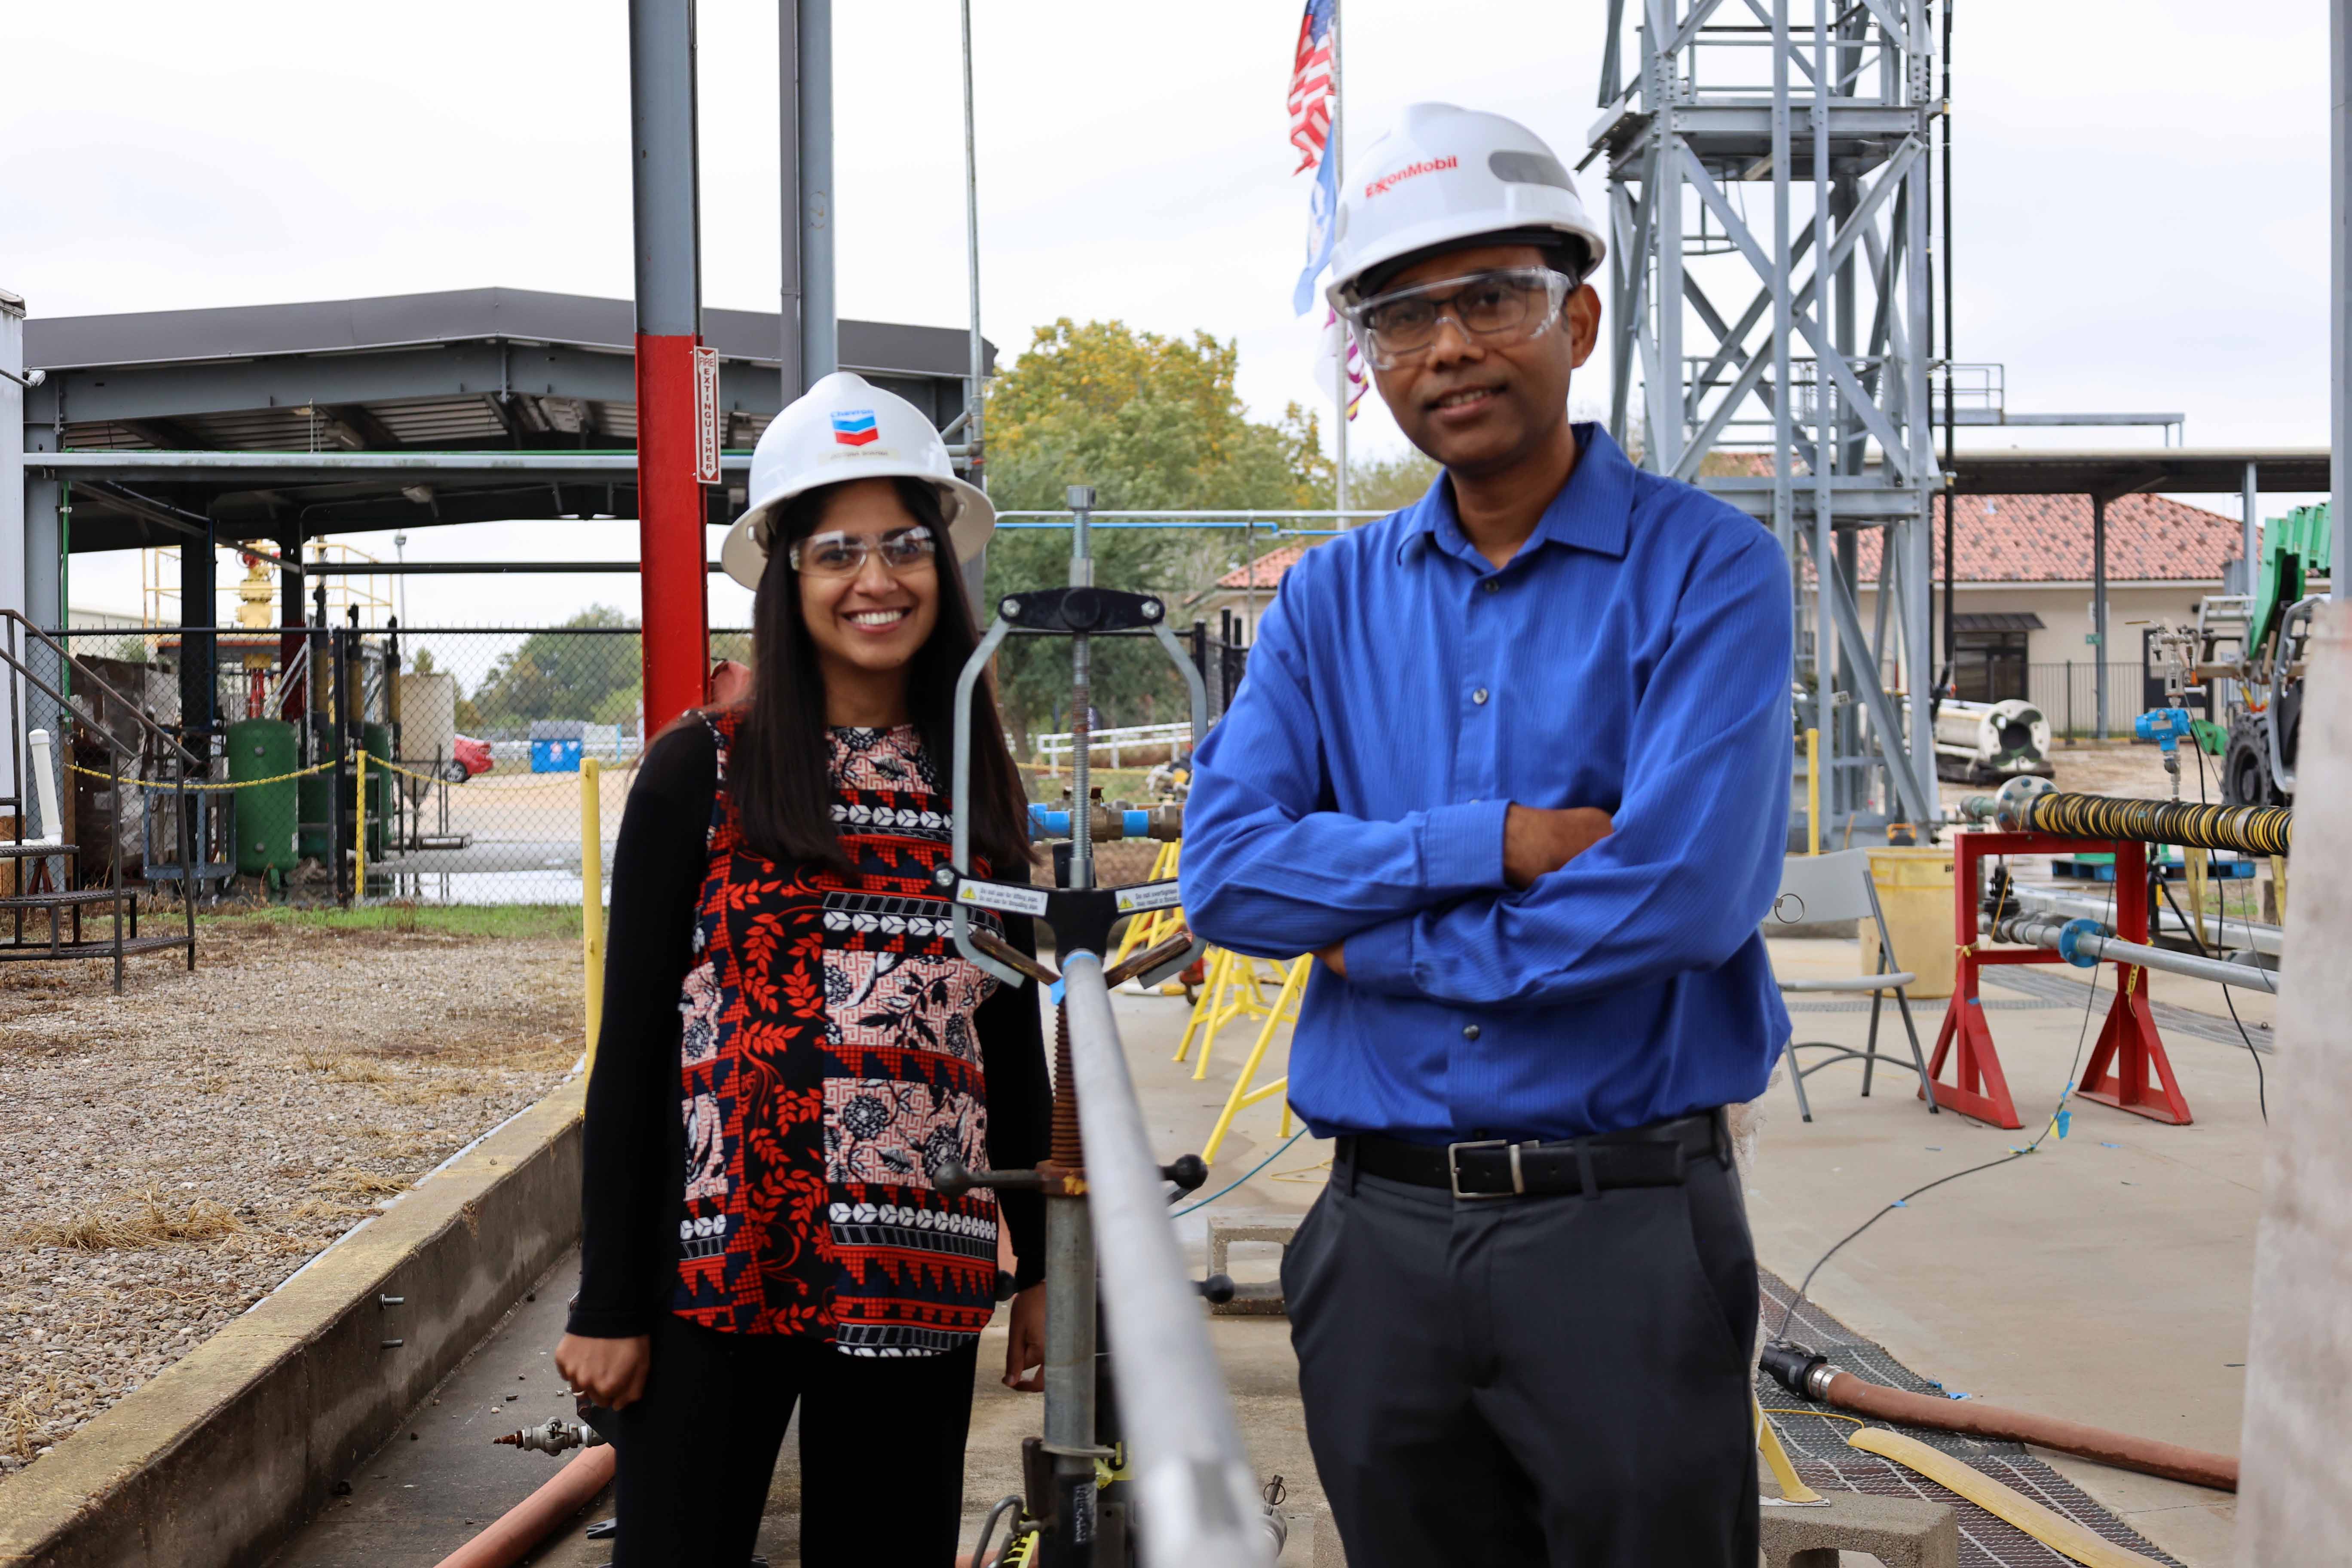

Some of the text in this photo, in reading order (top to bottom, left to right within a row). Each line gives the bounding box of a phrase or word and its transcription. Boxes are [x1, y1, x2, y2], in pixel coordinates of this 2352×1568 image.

[1365, 155, 1458, 199] ExxonMobil
[699, 358, 714, 366] FIRE
[704, 368, 713, 470] EXTINGUISHER
[830, 409, 874, 417] Chevron
